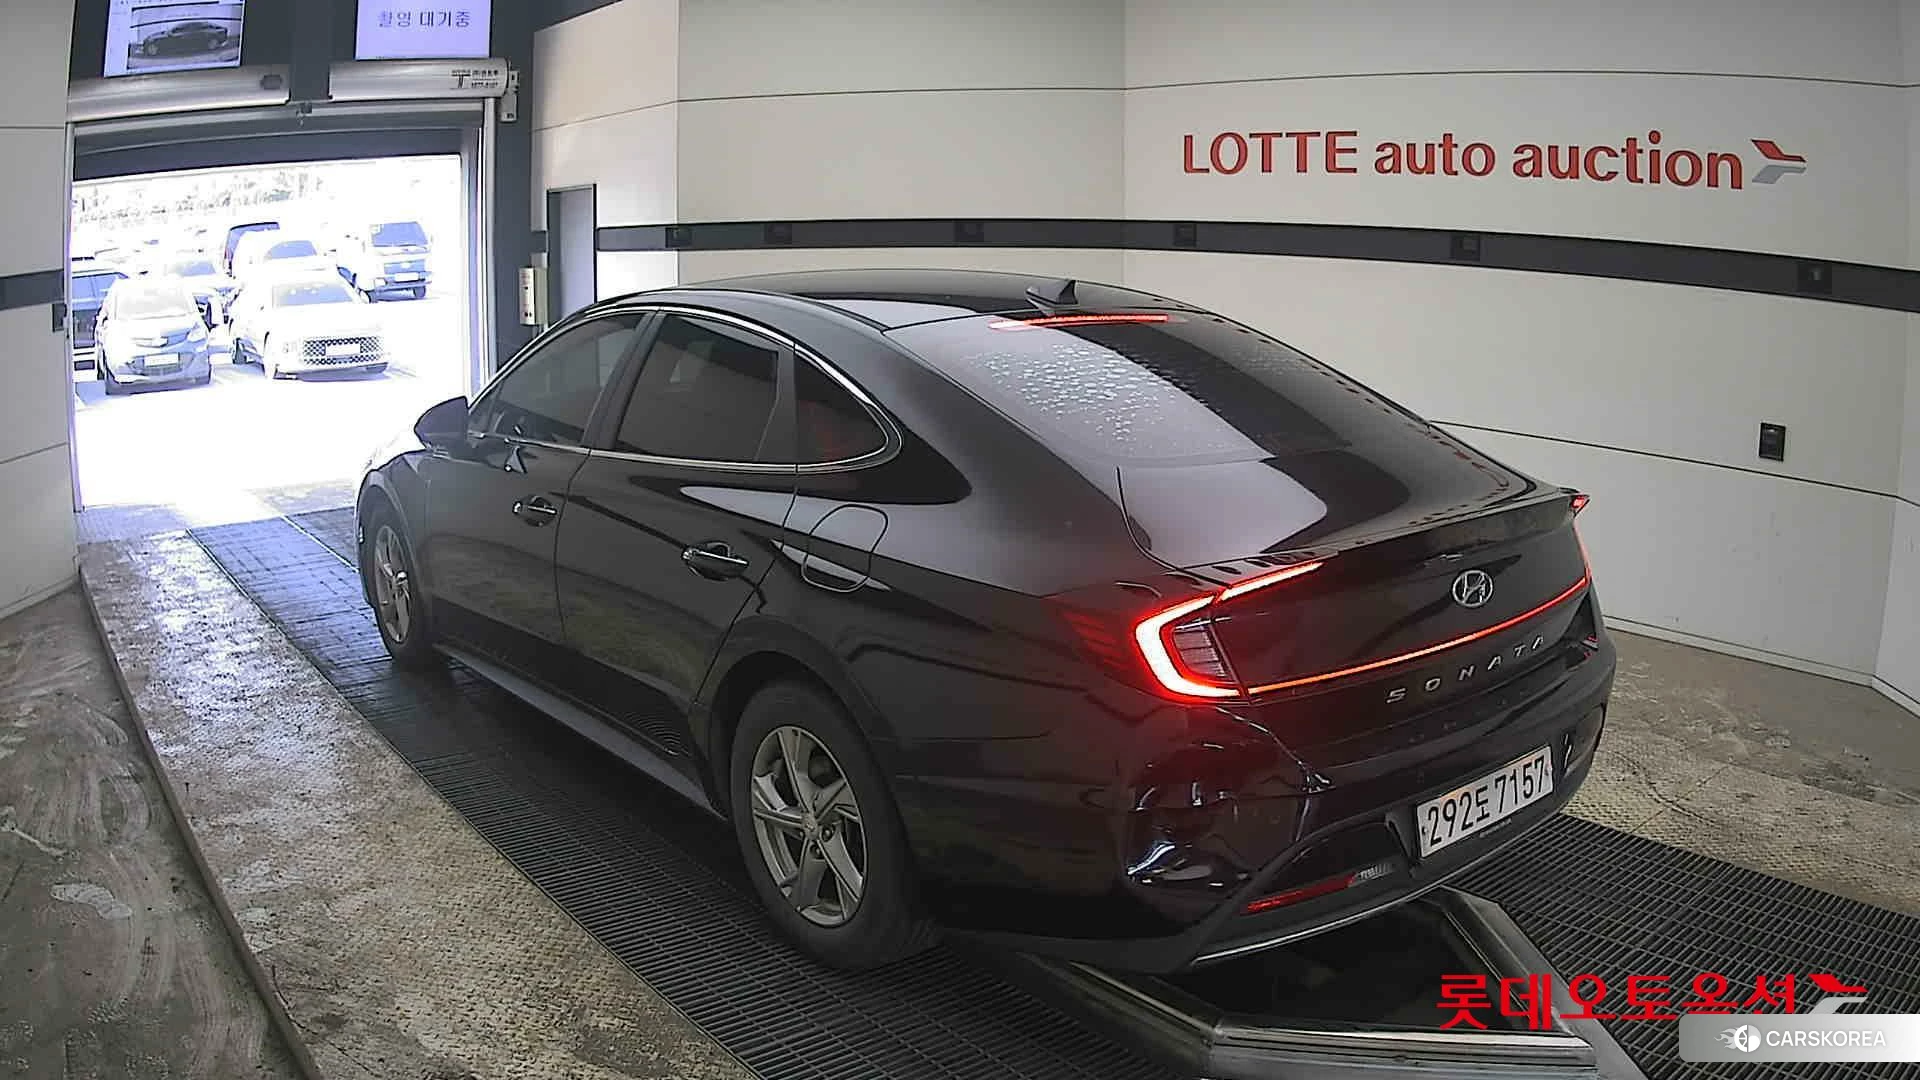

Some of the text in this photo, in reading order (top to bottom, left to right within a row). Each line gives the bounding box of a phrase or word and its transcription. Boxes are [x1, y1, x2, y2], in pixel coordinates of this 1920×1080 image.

[419, 10, 471, 28] 대기중
[1183, 130, 1744, 190] LOTTE auto auction
[1386, 635, 1545, 704] SONATA
